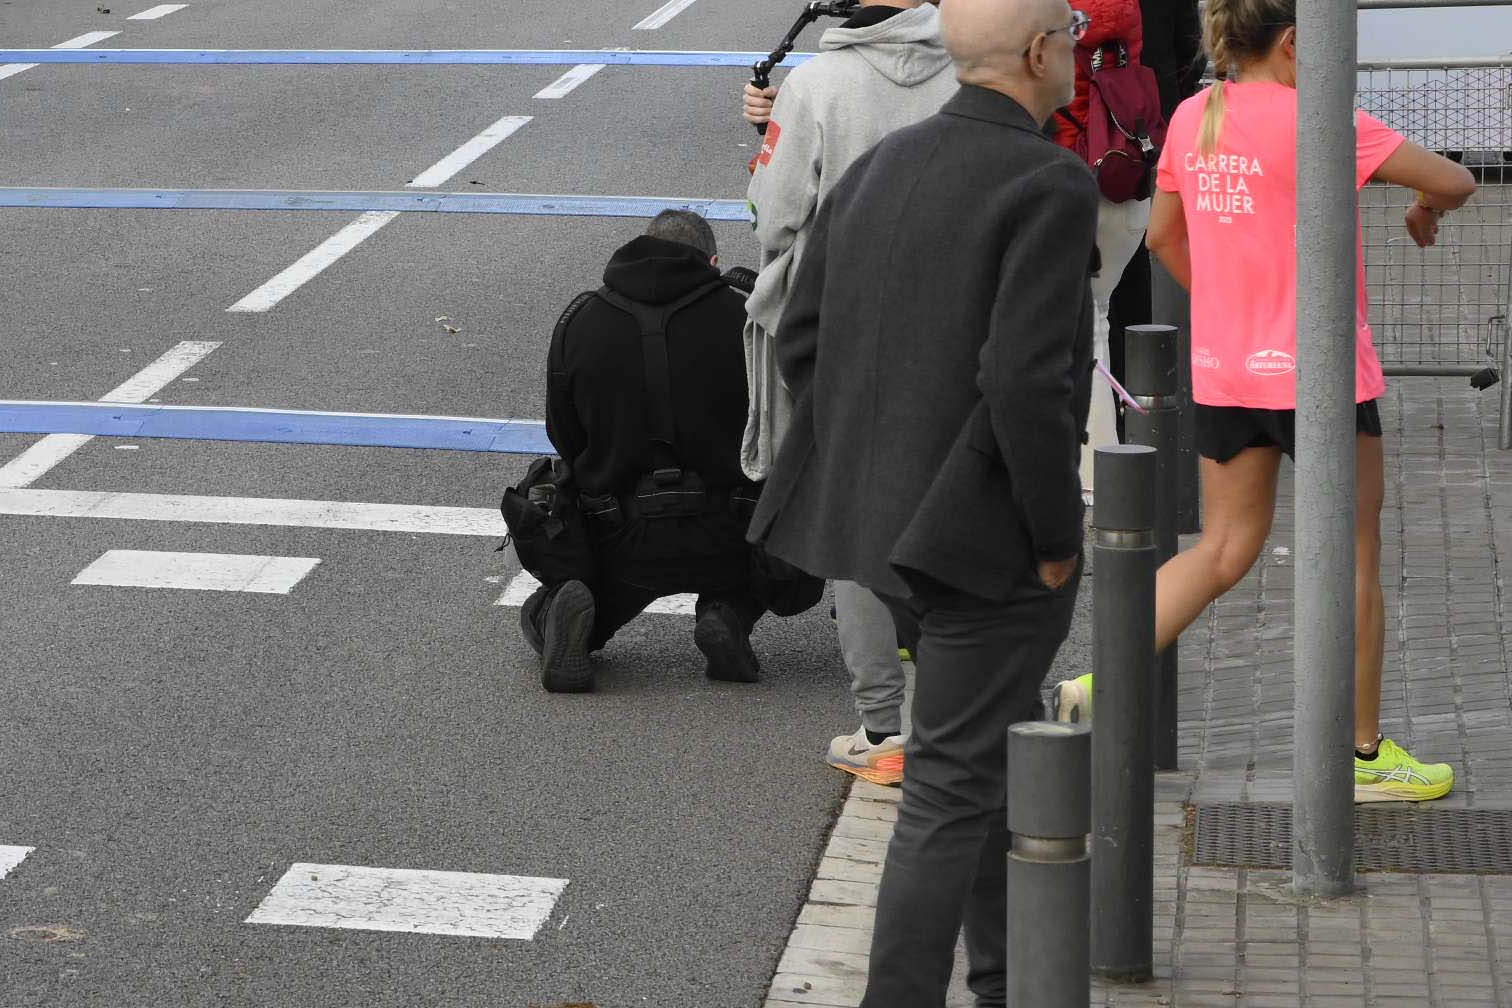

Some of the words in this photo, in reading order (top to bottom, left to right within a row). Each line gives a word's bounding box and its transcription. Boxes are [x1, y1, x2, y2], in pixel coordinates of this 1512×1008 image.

[1184, 152, 1263, 177] CARRERA
[1198, 172, 1220, 192] DE
[1226, 175, 1249, 193] LA
[1196, 195, 1255, 214] MUJER
